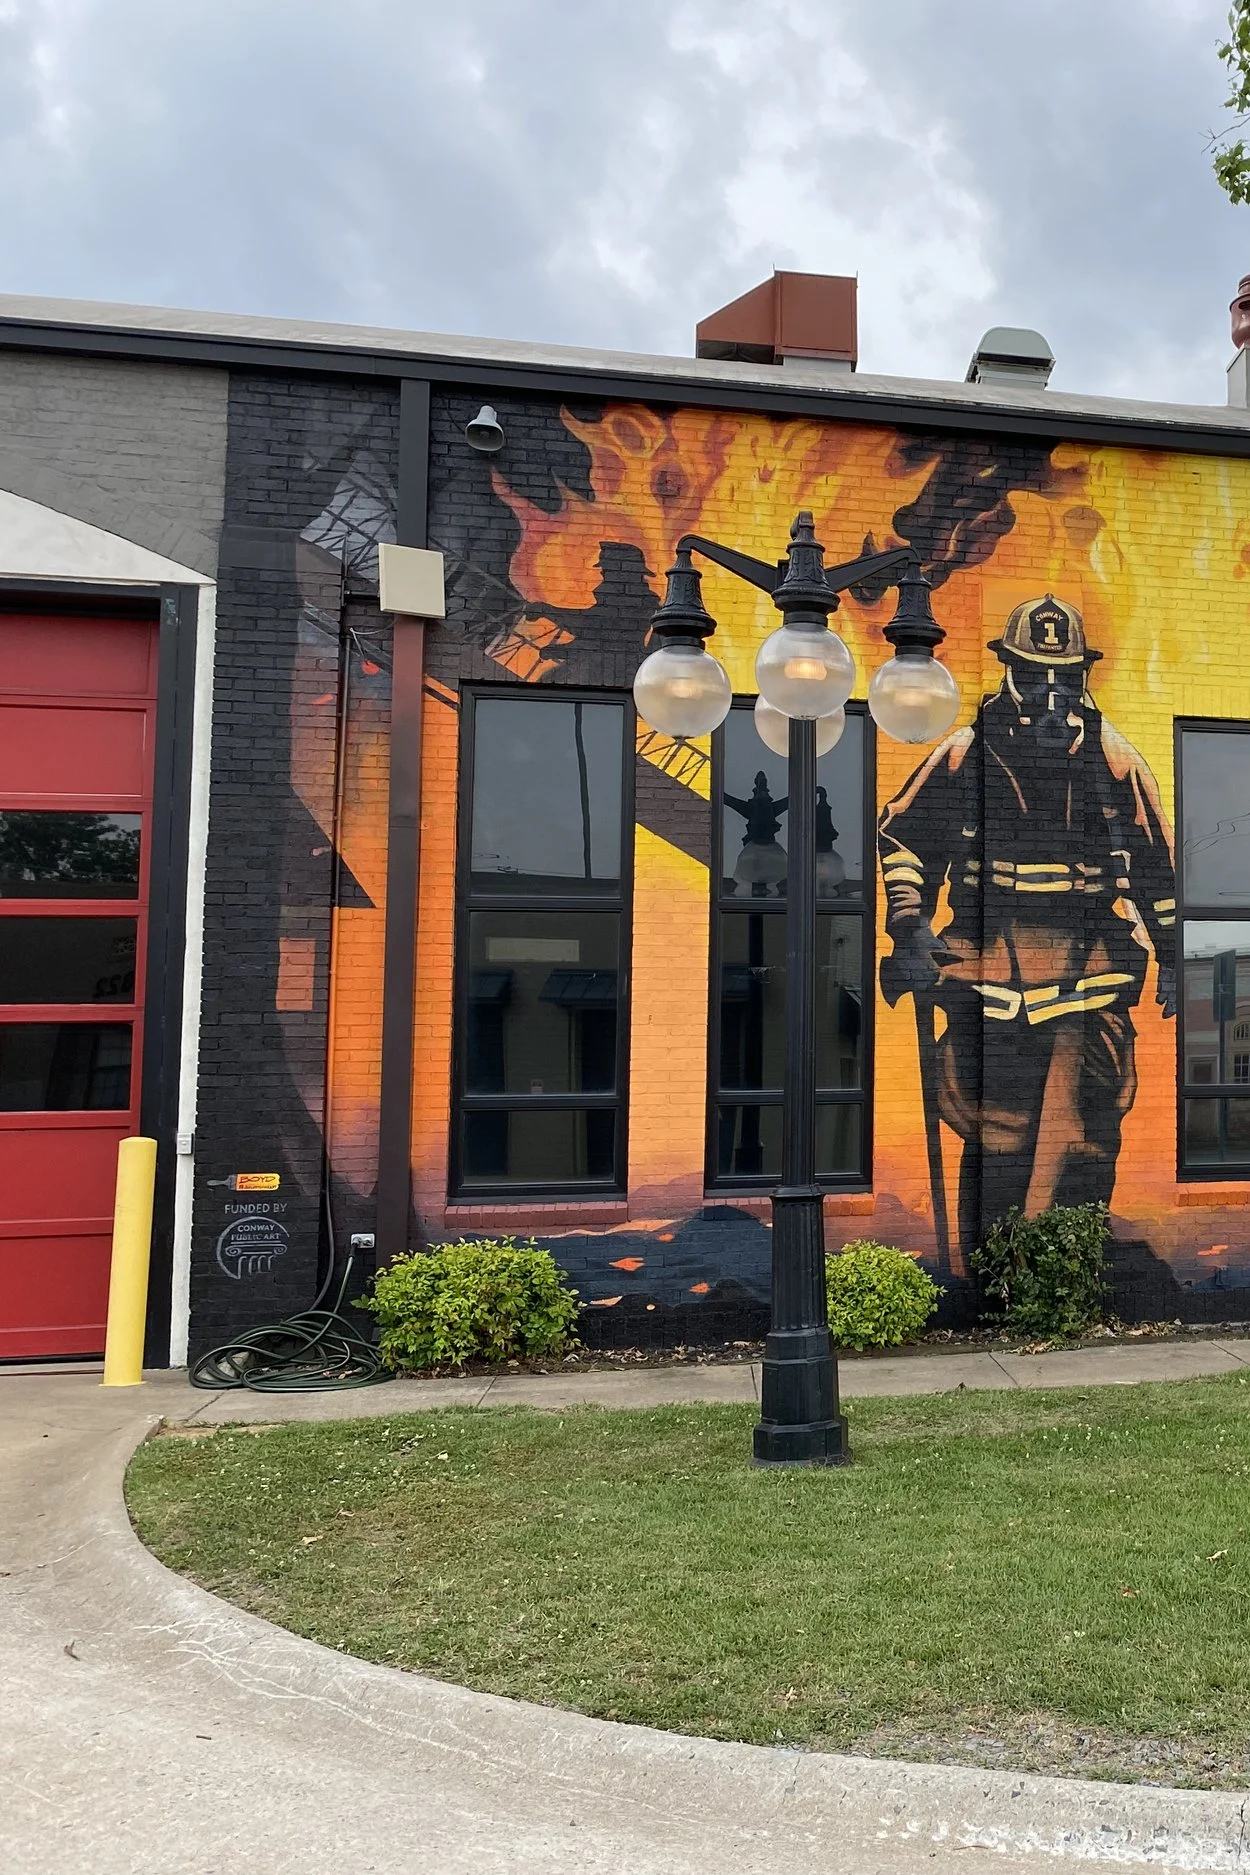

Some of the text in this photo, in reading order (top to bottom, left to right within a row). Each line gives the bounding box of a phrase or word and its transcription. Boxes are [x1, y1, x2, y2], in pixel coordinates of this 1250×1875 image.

[1035, 611, 1064, 622] CONWAY
[1044, 622, 1059, 644] 1
[239, 1175, 276, 1184] BOYD
[224, 1203, 288, 1214] FUNDED BY
[237, 1224, 275, 1233] CONWAY
[231, 1232, 281, 1241] PUBLIC ART
